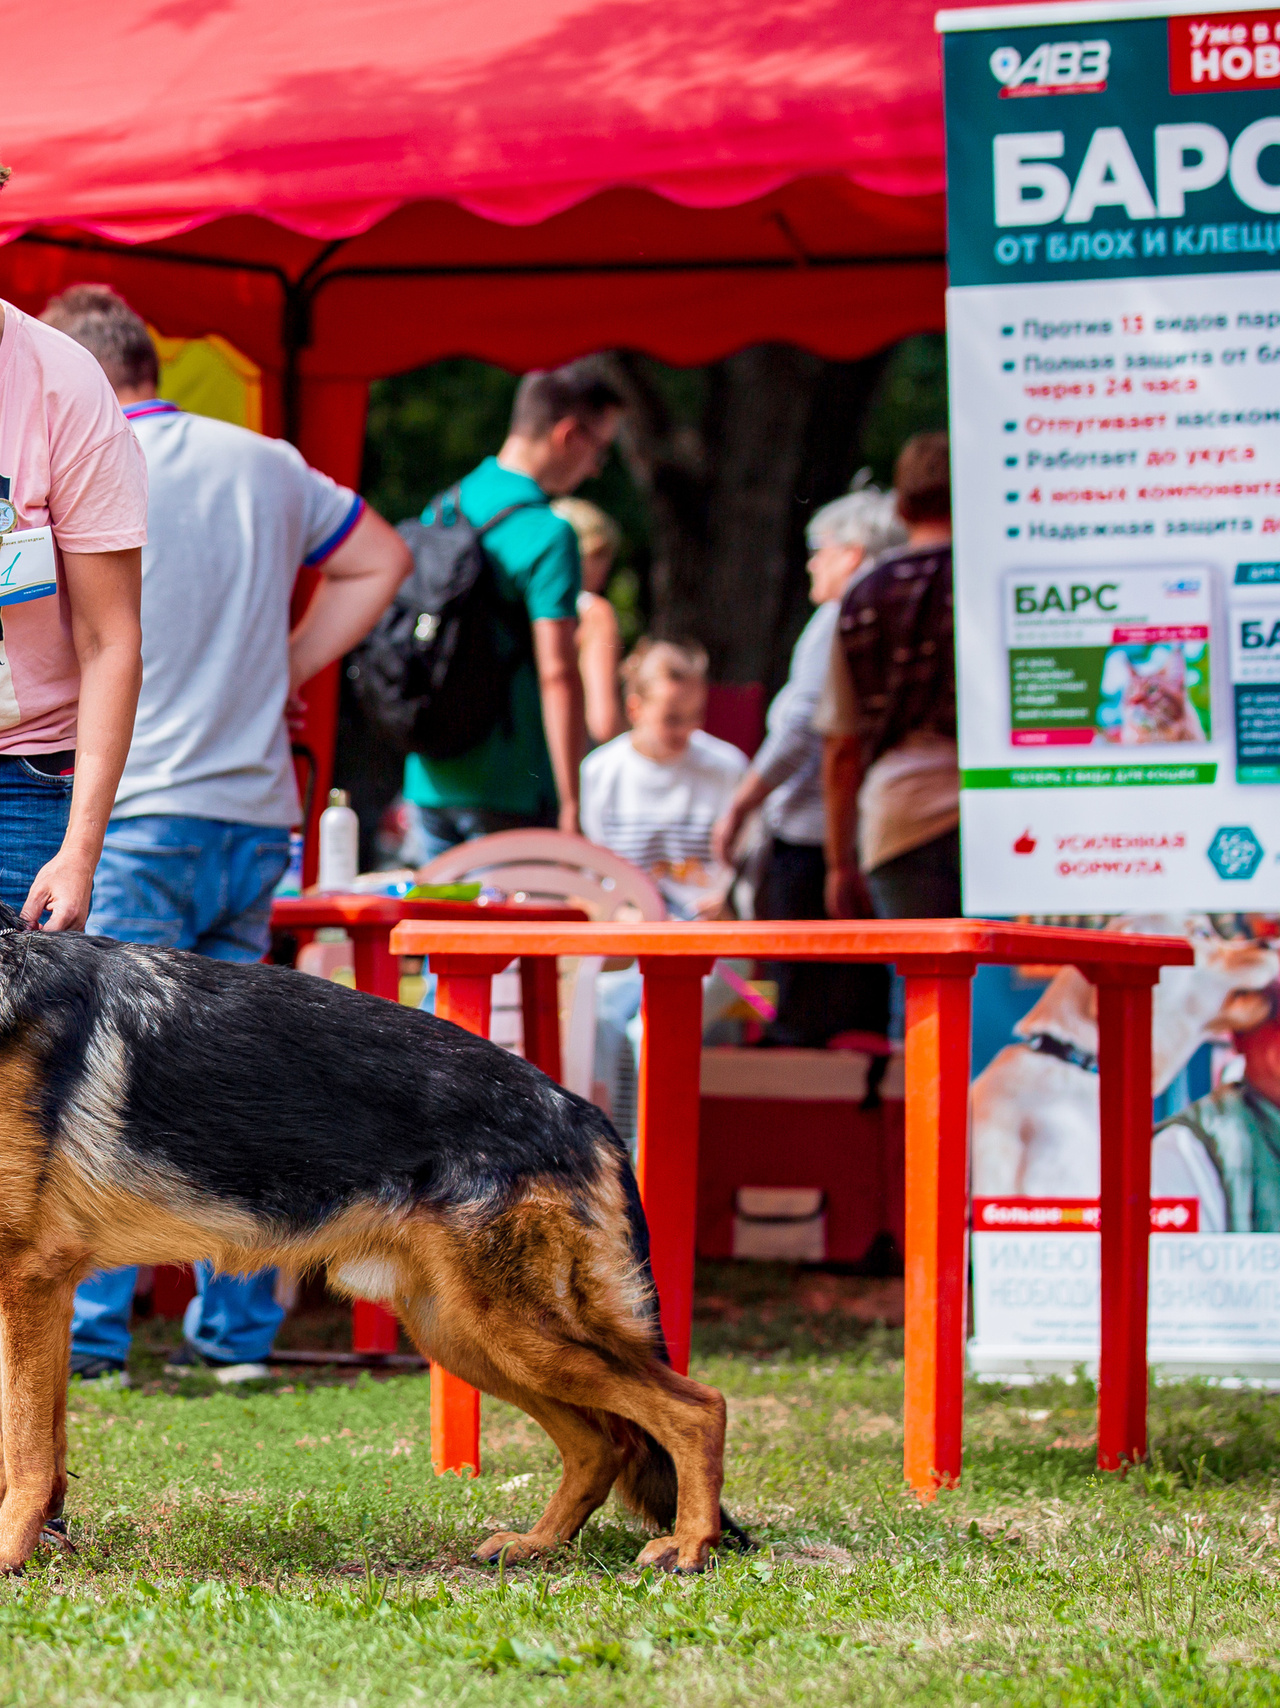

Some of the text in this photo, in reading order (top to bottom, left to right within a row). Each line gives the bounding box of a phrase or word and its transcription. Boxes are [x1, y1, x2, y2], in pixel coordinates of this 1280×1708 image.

[1189, 22, 1247, 48] Уже
[1252, 23, 1269, 43] в
[994, 221, 1280, 265] ОТ БЛОХ И КЛЕЩ
[1023, 318, 1112, 341] Против
[1122, 315, 1143, 334] 13
[1154, 313, 1227, 333] видов
[1023, 354, 1114, 374] Полная
[1125, 350, 1213, 370] защита
[1221, 347, 1247, 366] от
[1024, 375, 1198, 400] через 24 часа
[1025, 413, 1167, 437] Отпугивает
[1026, 445, 1256, 469] Работает до укуса
[1028, 486, 1042, 504] 4
[1052, 487, 1127, 503] новых
[1166, 516, 1253, 536] защита
[1014, 583, 1119, 616] БАРС
[1057, 834, 1186, 851] УСИЛЕННАЯ
[1058, 861, 1163, 877] ФОРМУЛА
